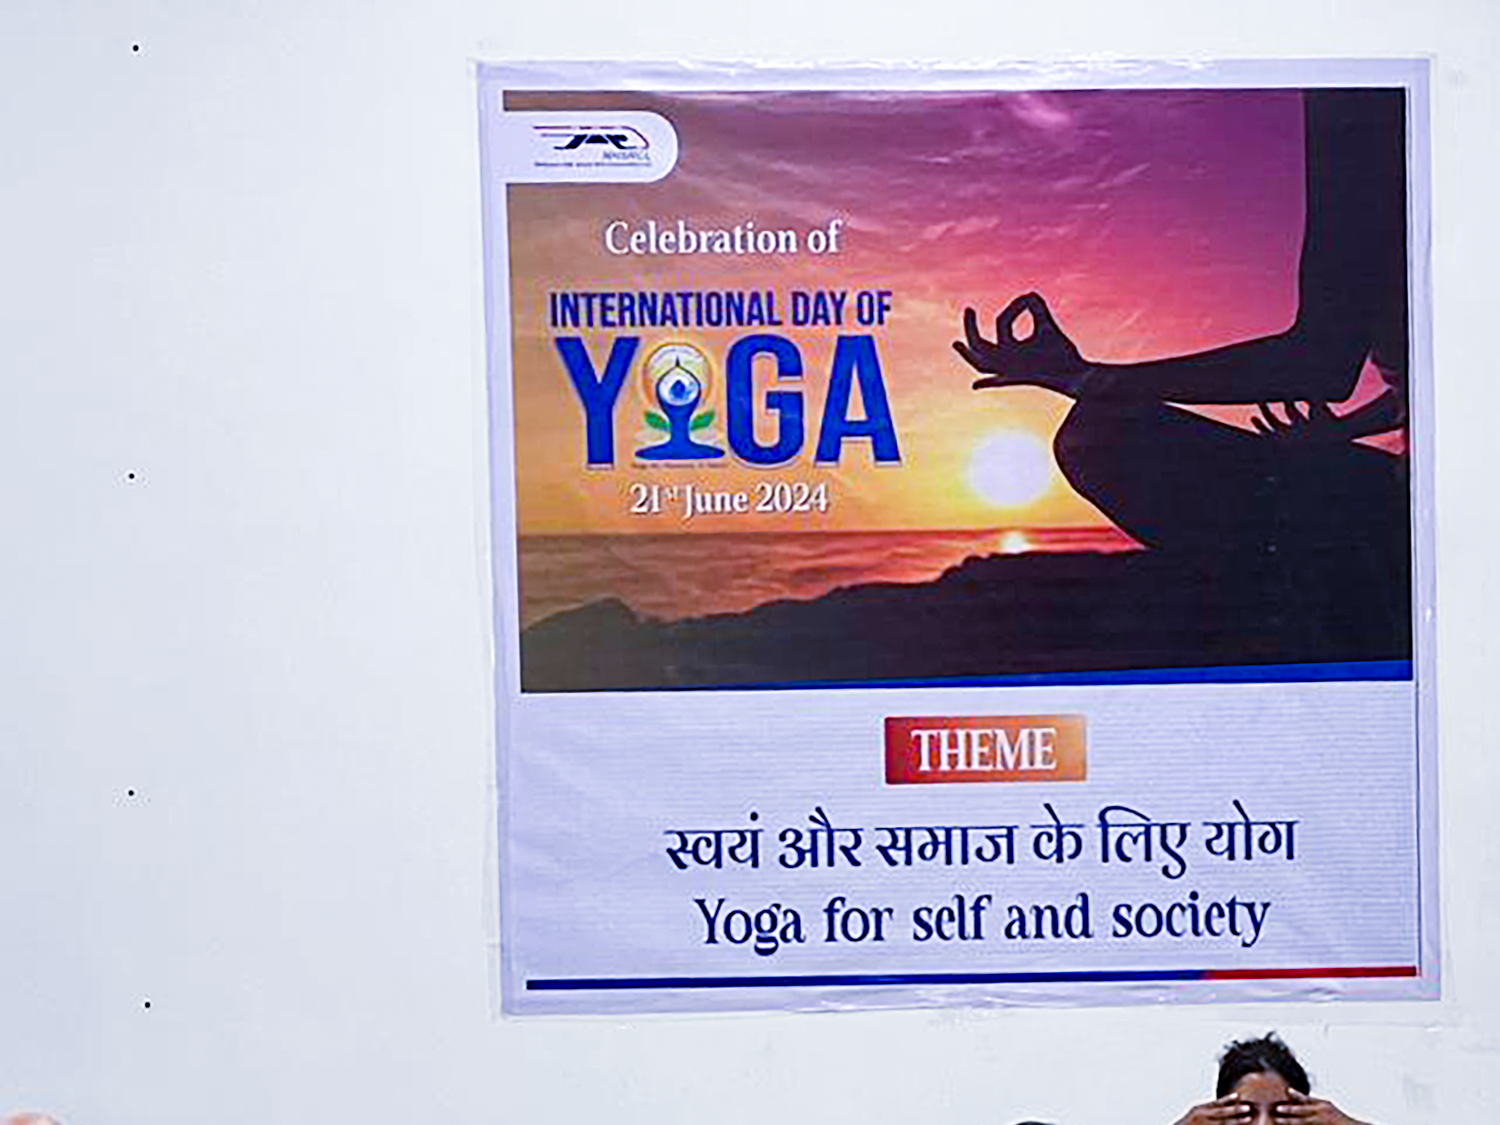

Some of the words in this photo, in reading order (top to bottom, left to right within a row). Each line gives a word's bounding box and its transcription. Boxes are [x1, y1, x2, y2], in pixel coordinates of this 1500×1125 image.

[604, 219, 798, 255] Celebration
[807, 219, 843, 255] of
[550, 291, 783, 328] INTERNATIONAL
[791, 290, 846, 327] DAY
[856, 290, 893, 326] OF
[681, 484, 749, 520] June
[755, 483, 828, 513] 2024
[911, 726, 1057, 773] THEME
[664, 811, 764, 870] स्वयं
[778, 806, 864, 868] और
[875, 825, 1019, 866] समाज
[1030, 802, 1084, 863] के
[1096, 805, 1192, 879] लिए
[1202, 799, 1300, 861] योग
[693, 898, 806, 956] Yoga
[823, 896, 894, 942] for
[912, 894, 992, 940] self
[1004, 892, 1094, 939] and
[1112, 890, 1272, 948] society
